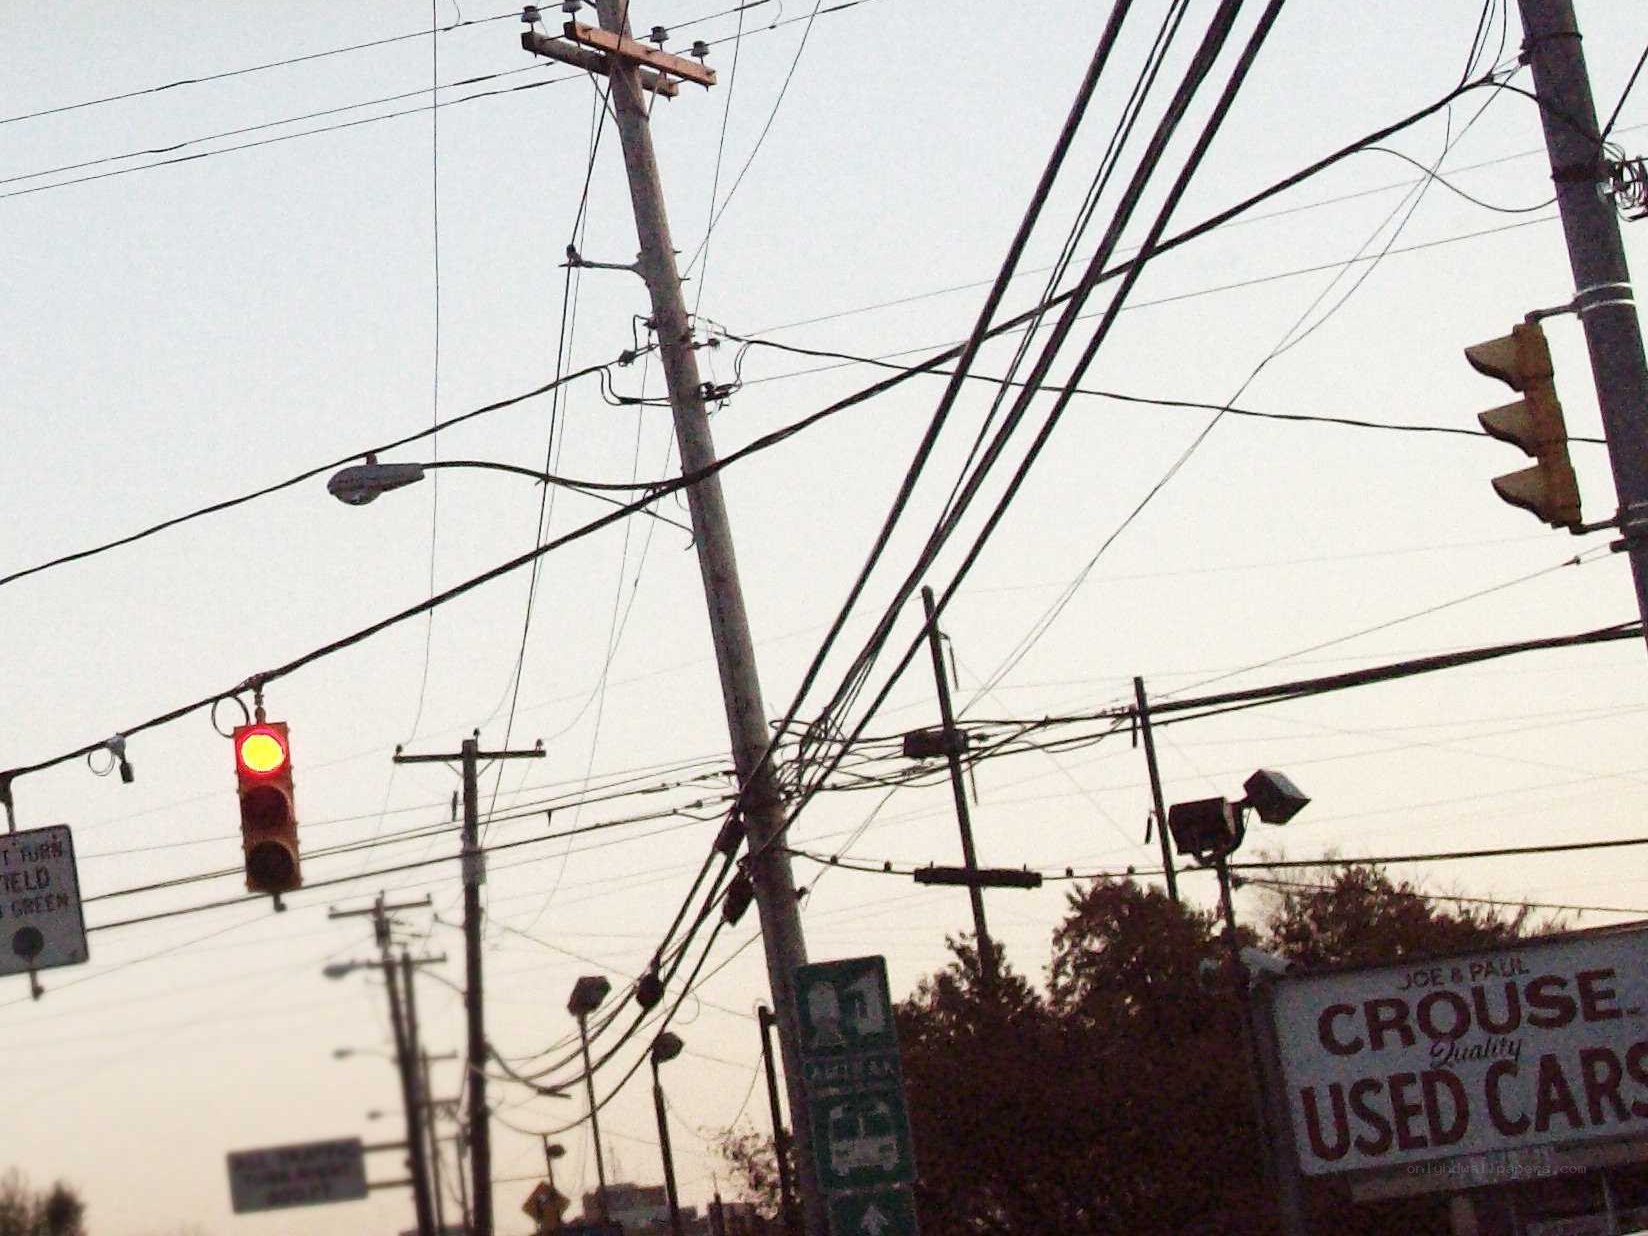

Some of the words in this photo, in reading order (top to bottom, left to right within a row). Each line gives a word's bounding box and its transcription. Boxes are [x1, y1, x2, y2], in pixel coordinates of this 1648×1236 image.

[19, 842, 62, 864] TURN
[10, 892, 70, 918] GREEN
[1397, 967, 1444, 990] JOE
[1470, 958, 1529, 982] PAUL
[1428, 1038, 1522, 1068] Quality
[1299, 1068, 1470, 1162] USED
